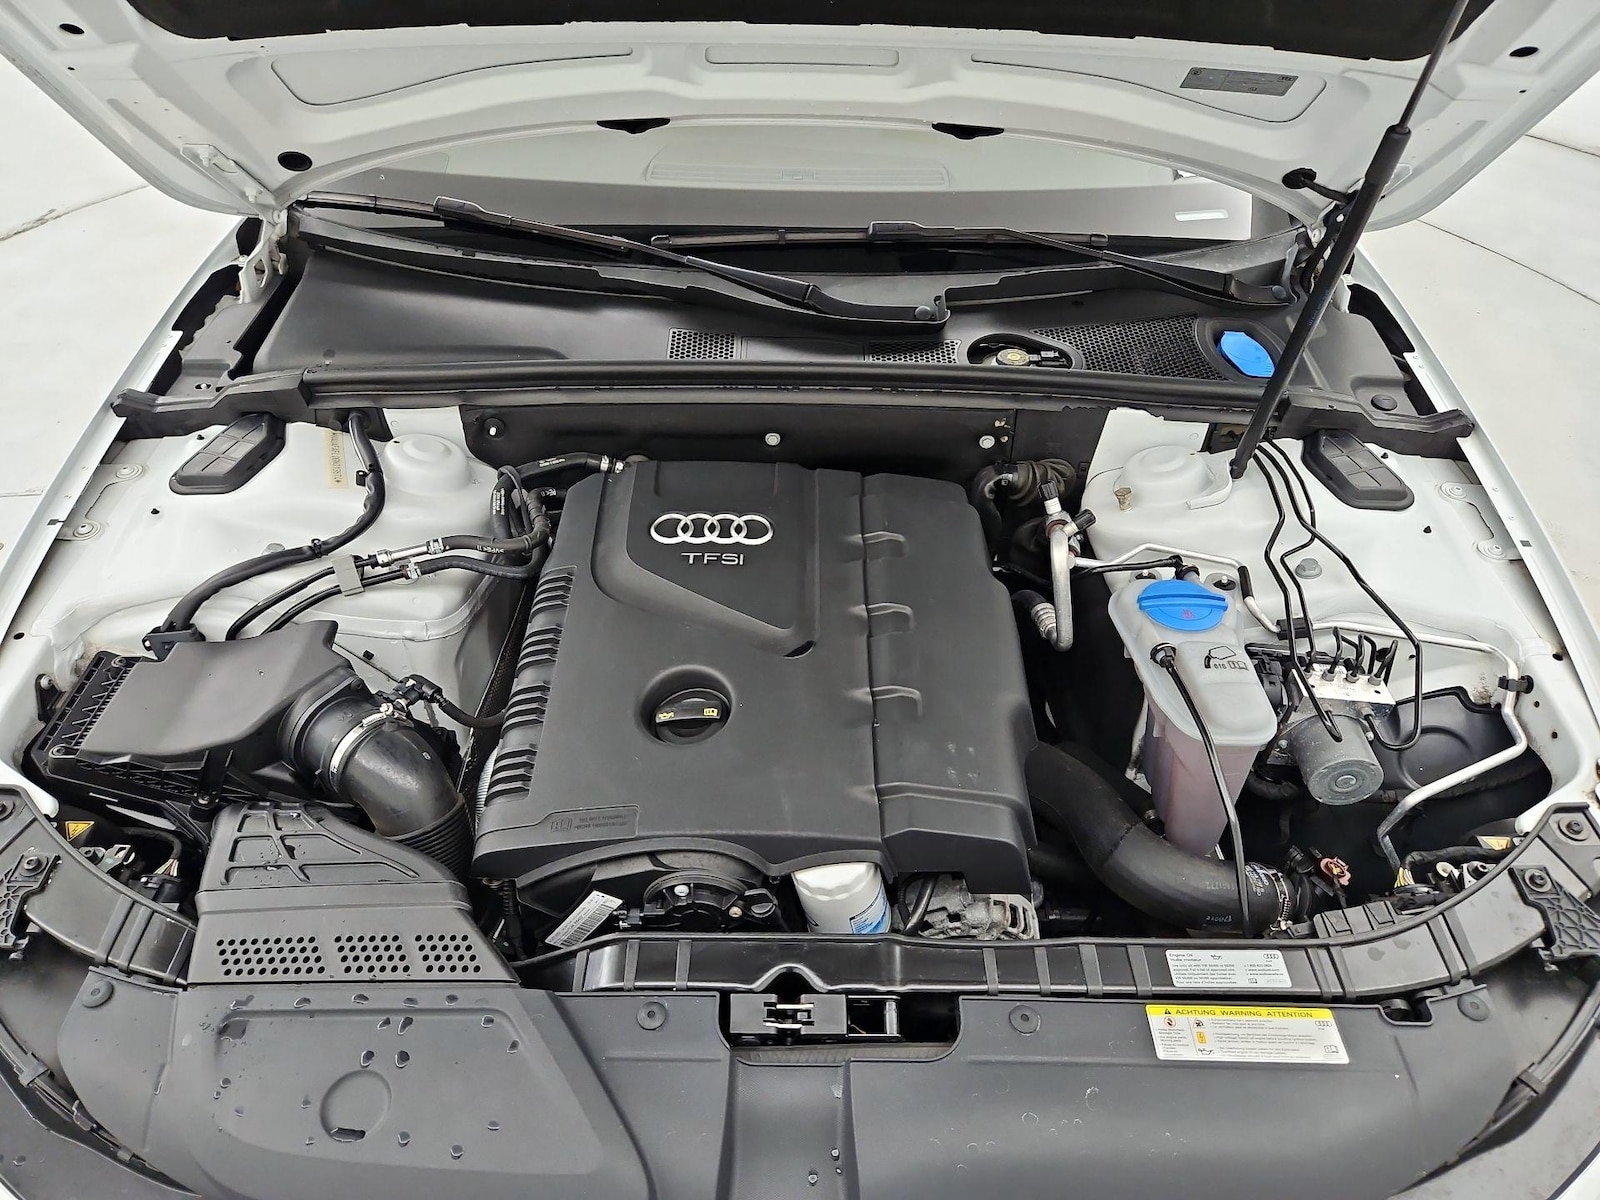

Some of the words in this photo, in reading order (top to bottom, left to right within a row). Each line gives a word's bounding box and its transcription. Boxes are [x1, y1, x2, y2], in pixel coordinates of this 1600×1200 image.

[681, 552, 744, 565] TFSI
[1220, 1009, 1263, 1017] WARNING
[1266, 1010, 1313, 1018] ATTENTION
